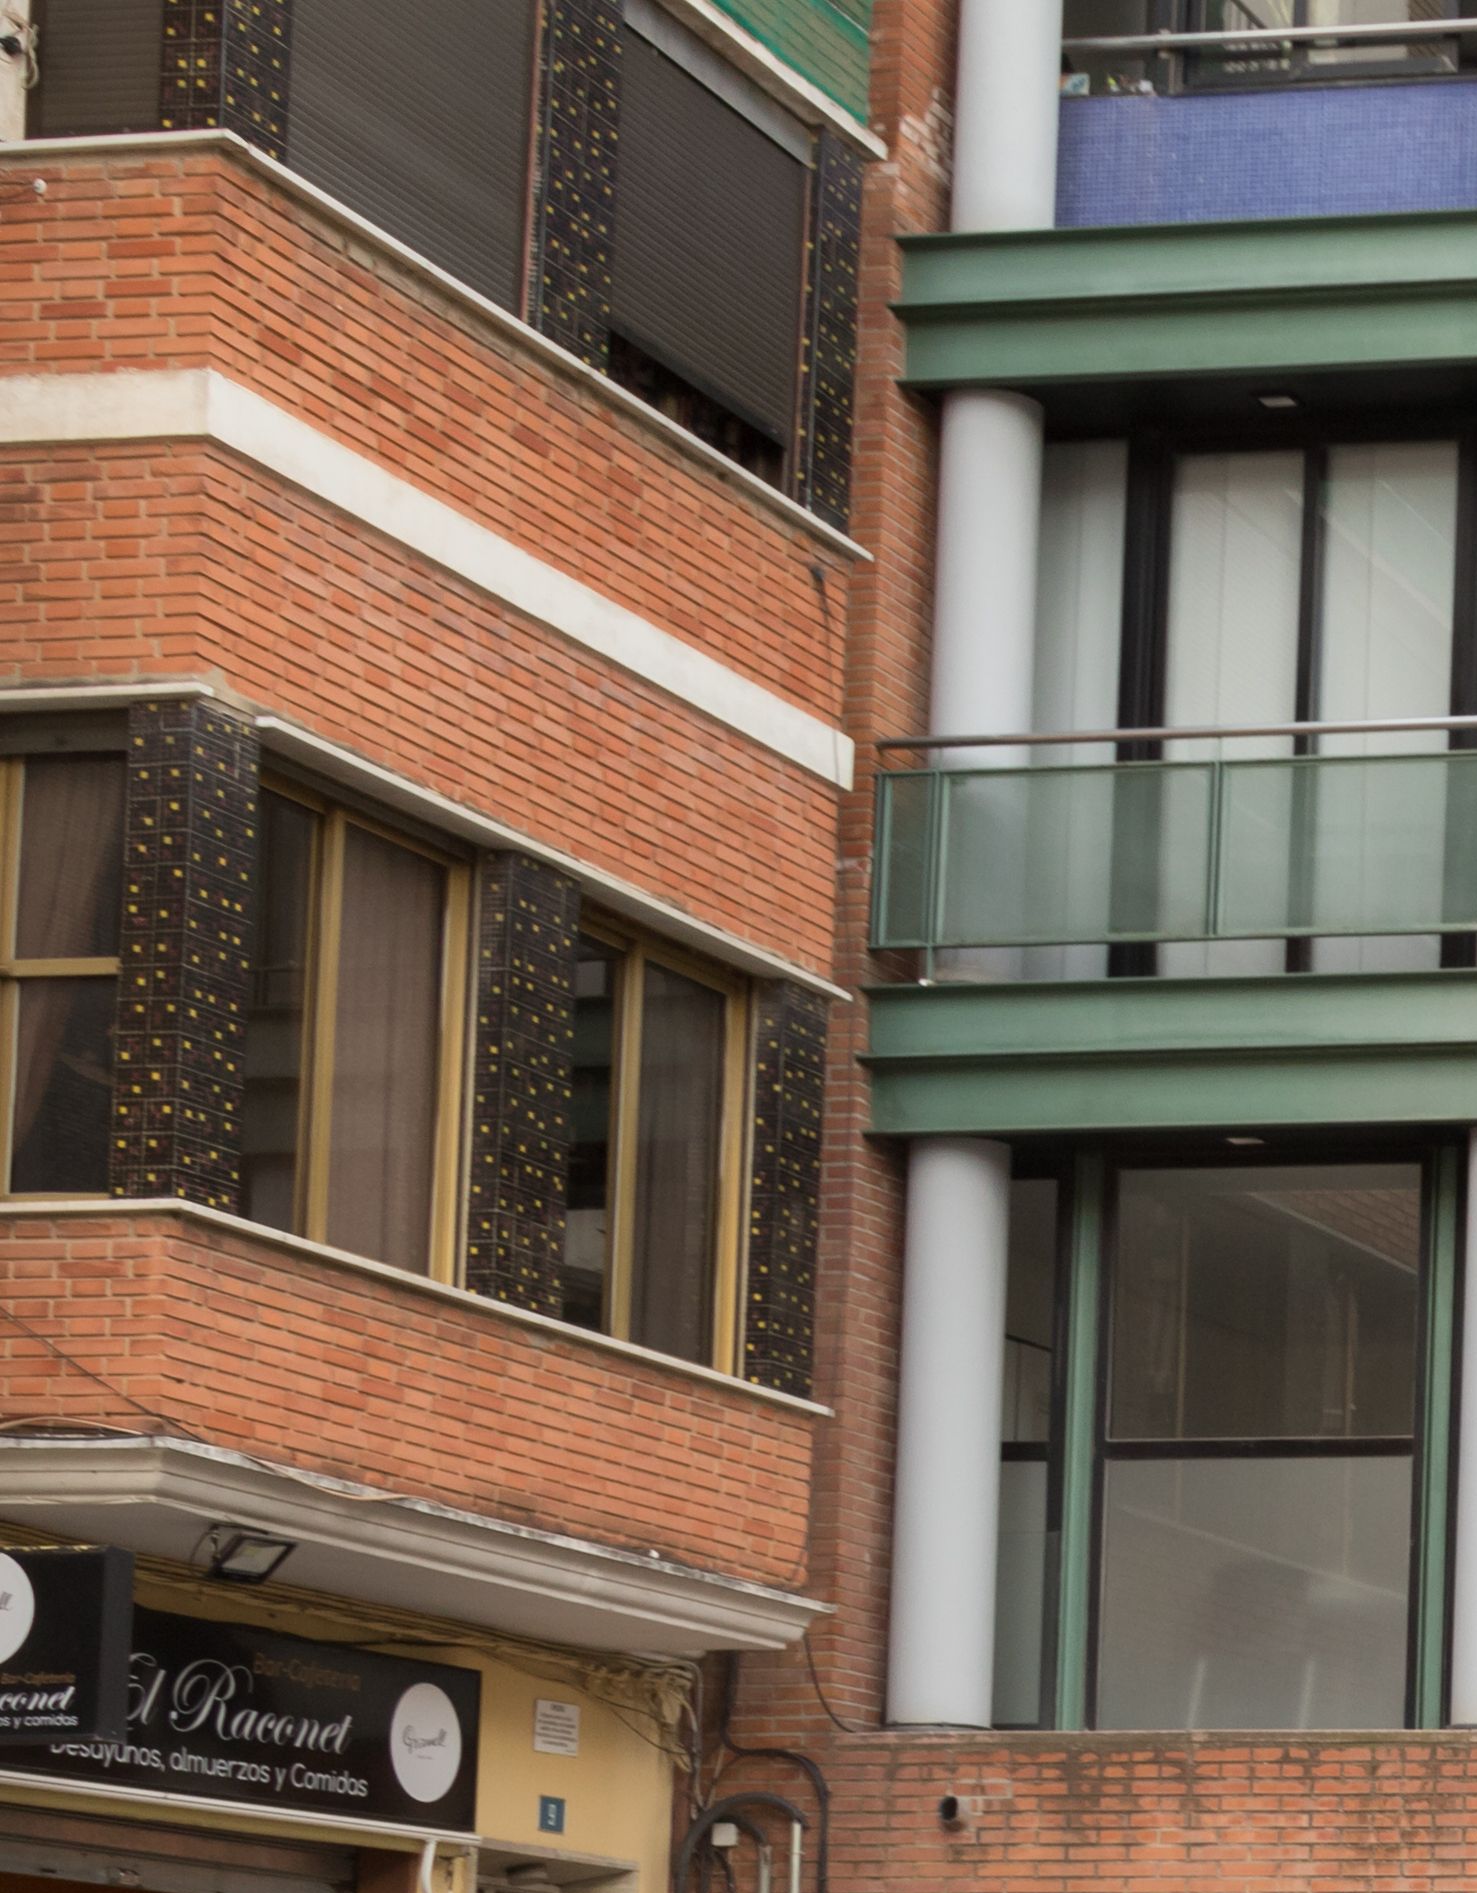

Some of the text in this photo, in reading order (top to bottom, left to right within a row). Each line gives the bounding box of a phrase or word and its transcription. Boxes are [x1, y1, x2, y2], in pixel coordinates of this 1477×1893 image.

[0, 1686, 76, 1711] conet
[170, 1659, 353, 1755] Raconet
[24, 1713, 79, 1727] comidas
[170, 1746, 271, 1783] almuerzos
[275, 1767, 288, 1792] y
[290, 1763, 369, 1797] Comidas
